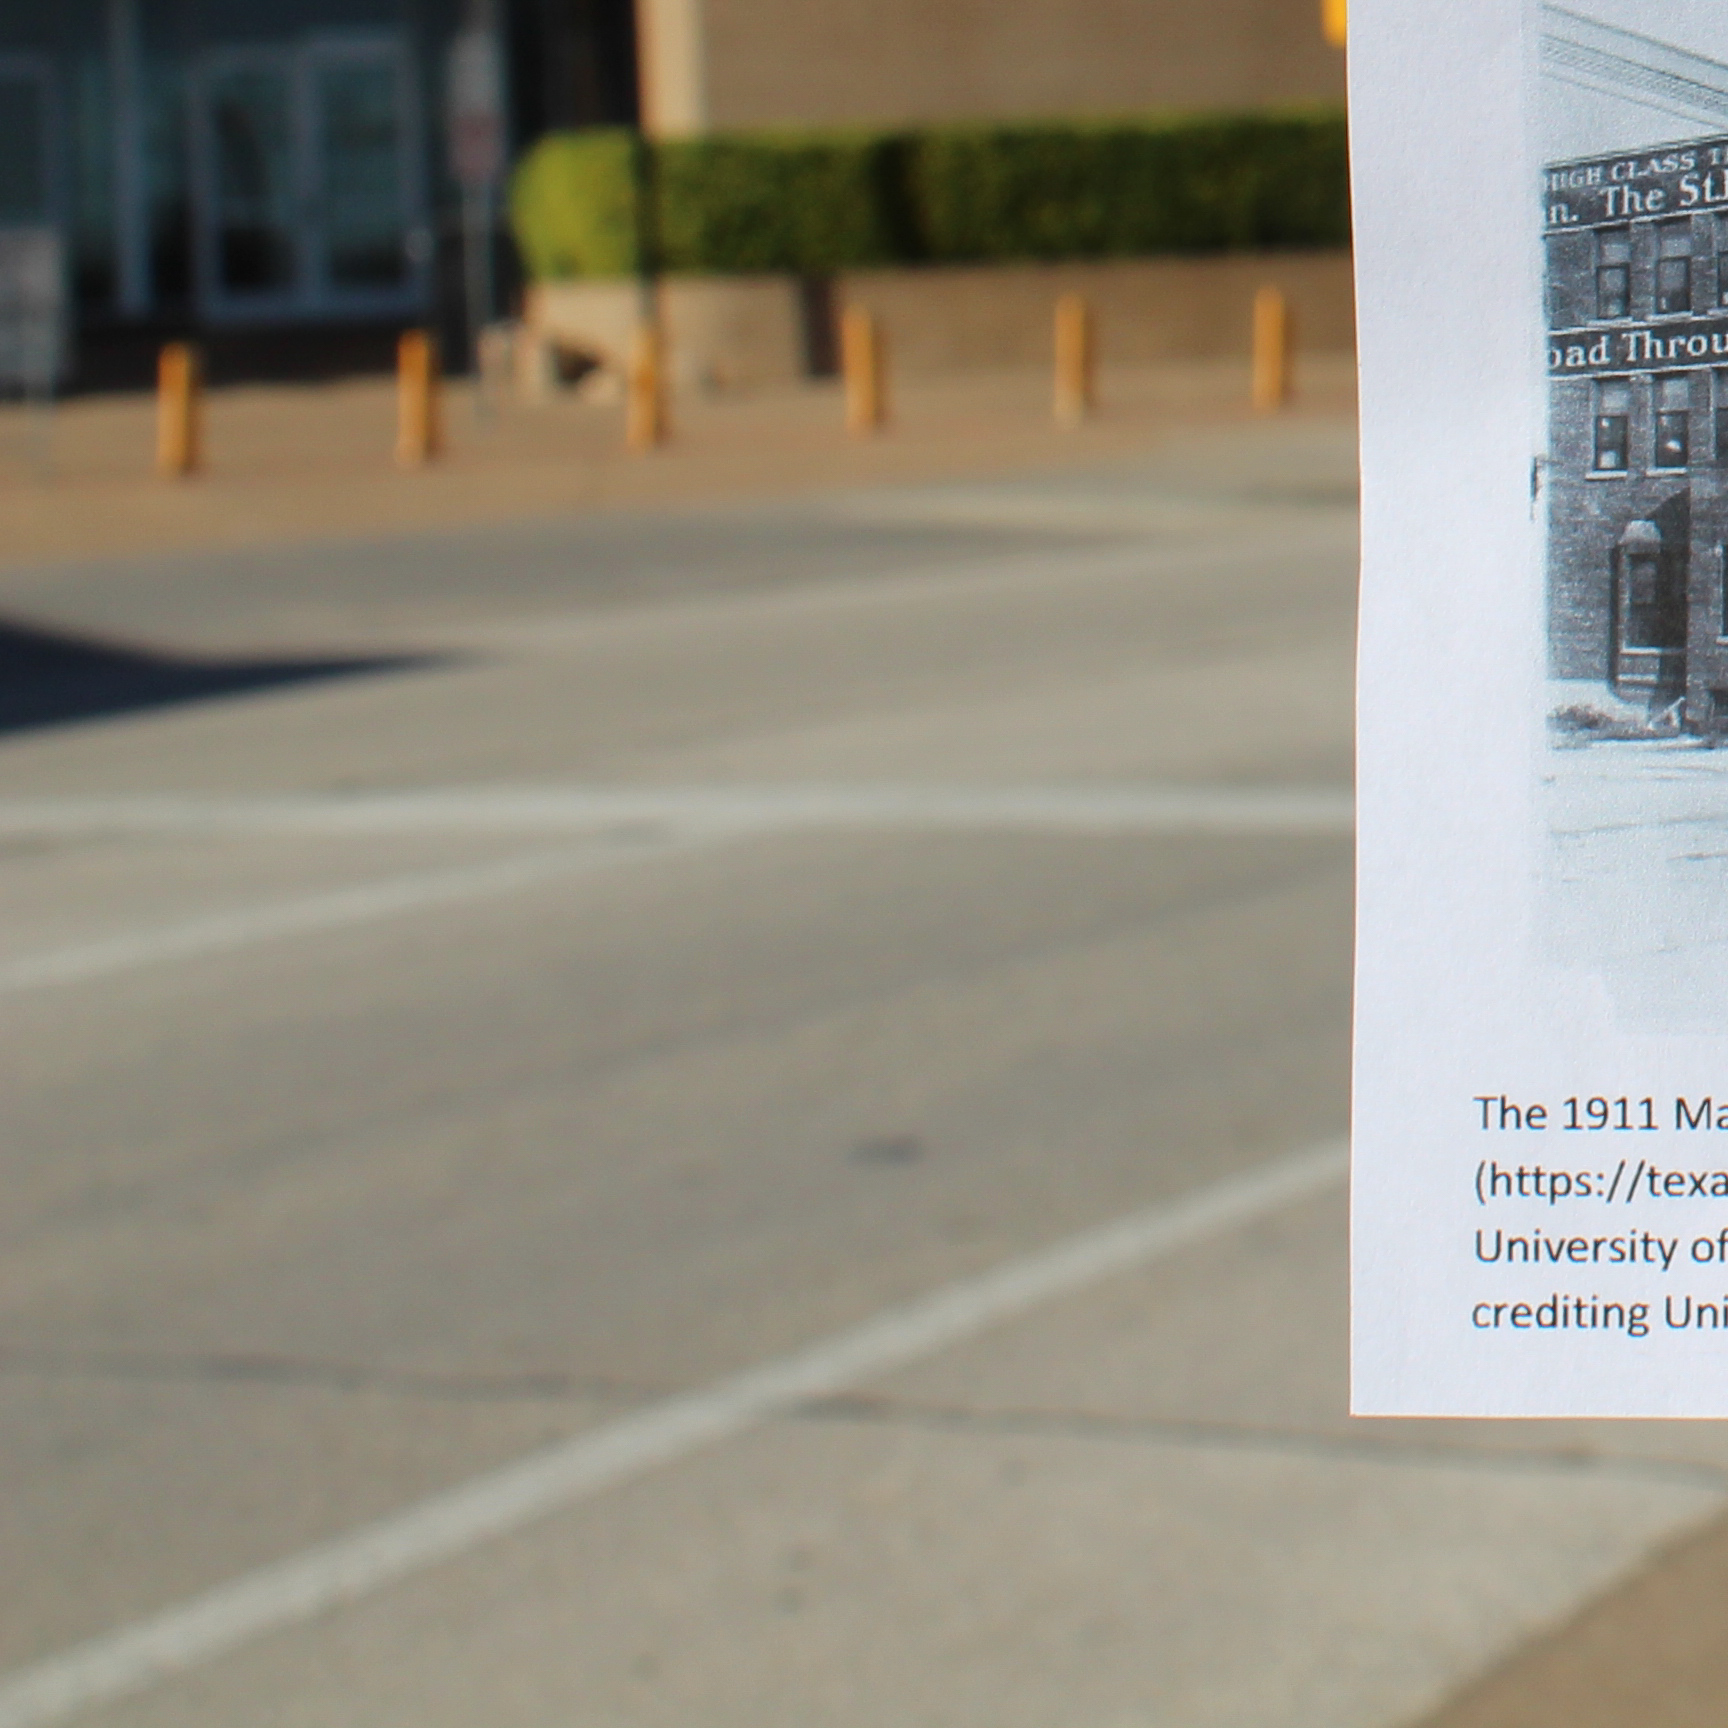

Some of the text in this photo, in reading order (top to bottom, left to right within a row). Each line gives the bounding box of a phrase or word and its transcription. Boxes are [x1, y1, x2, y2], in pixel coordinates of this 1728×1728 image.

[1611, 150, 1697, 183] CLASS
[1599, 183, 1667, 218] The
[1474, 1095, 1547, 1131] The
[1563, 1096, 1659, 1131] 1911
[1475, 1228, 1679, 1272] University
[1471, 1293, 1650, 1338] crediting
